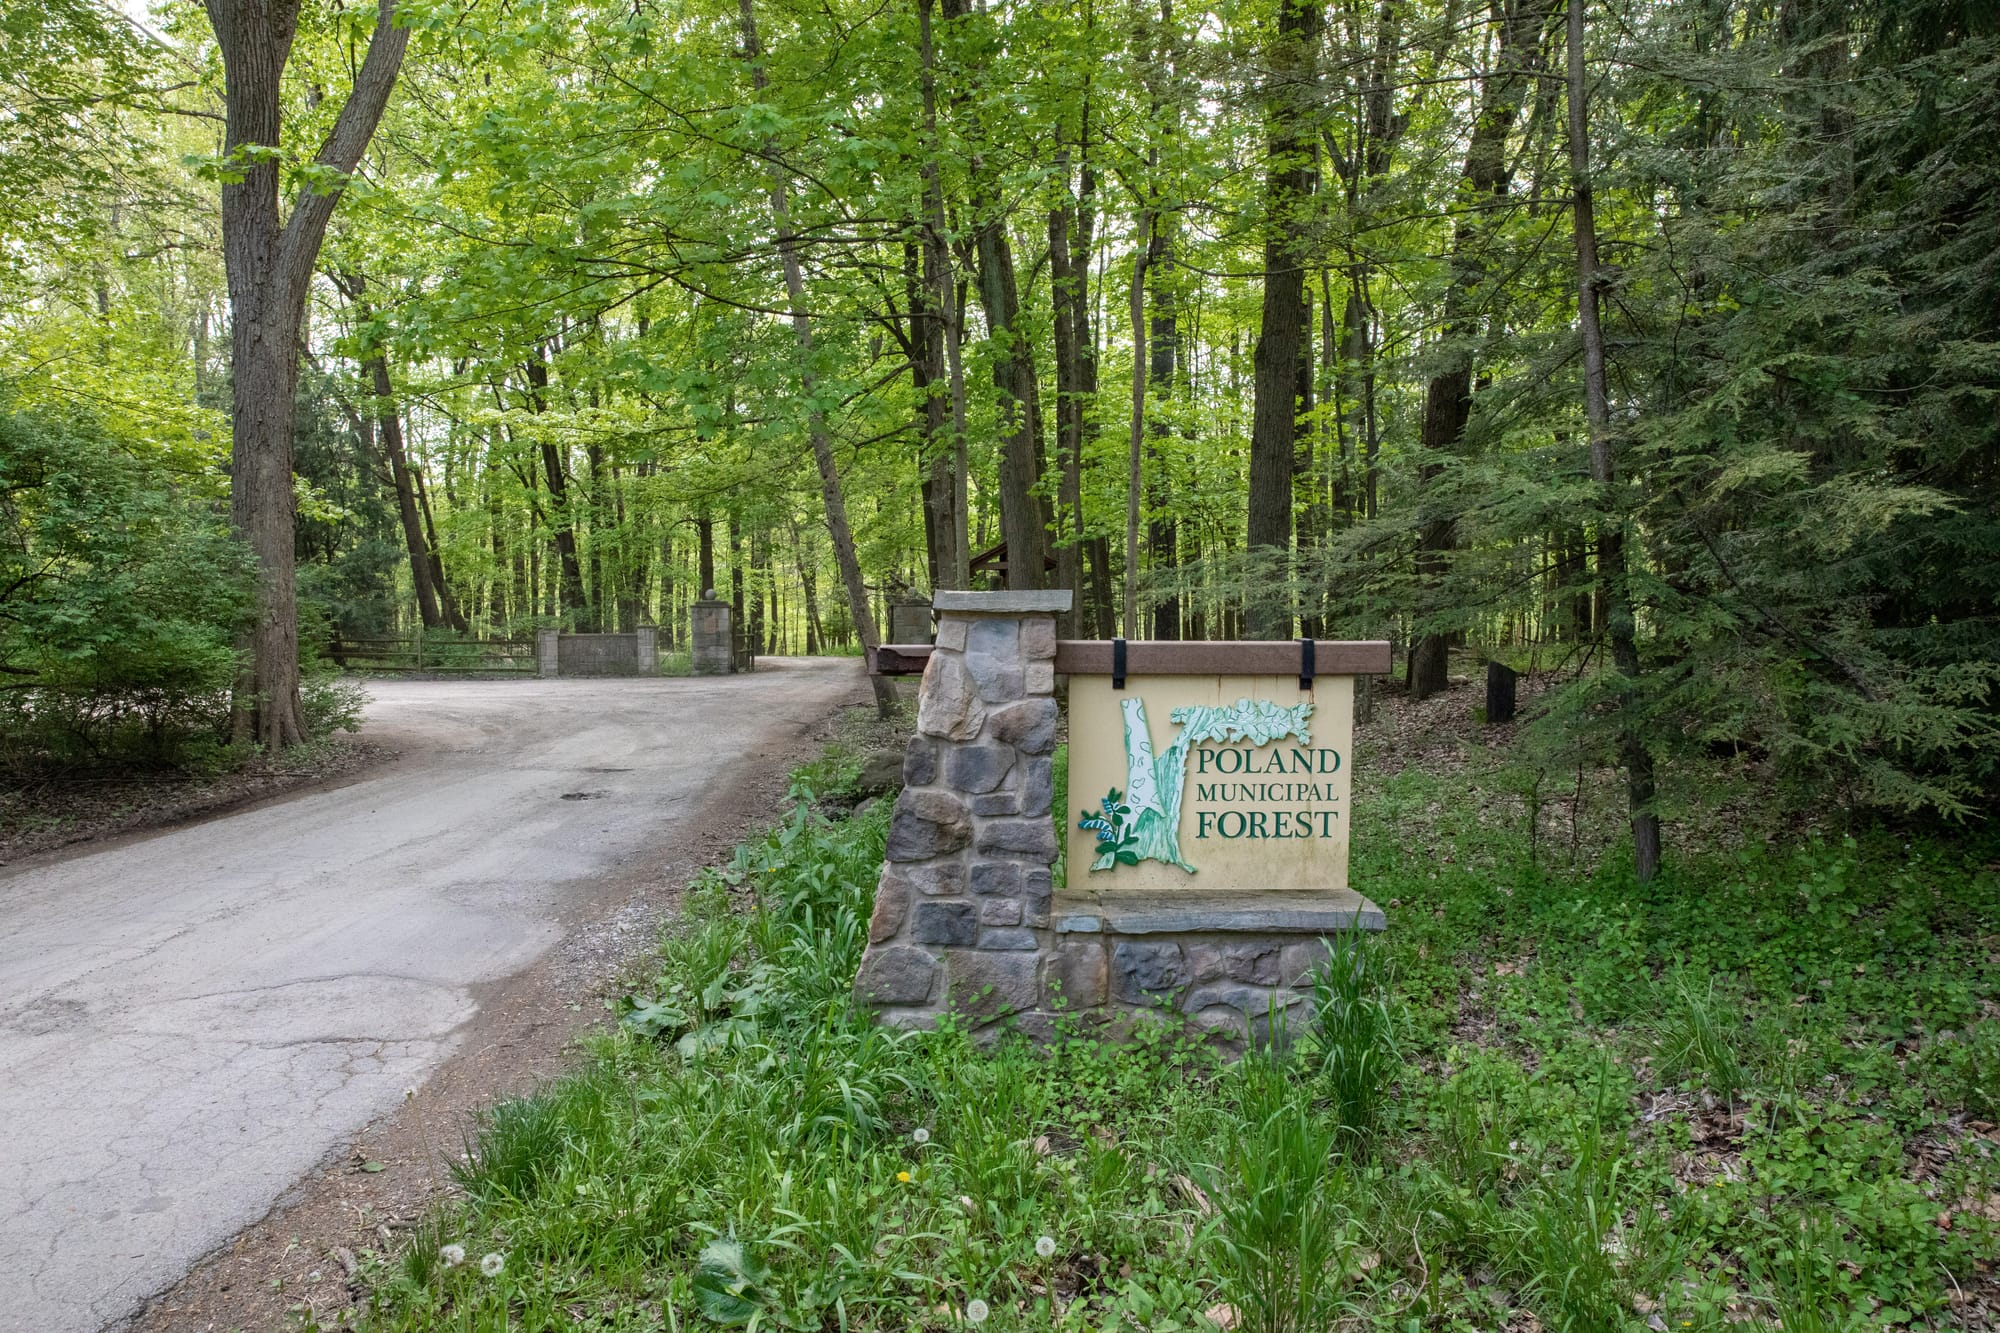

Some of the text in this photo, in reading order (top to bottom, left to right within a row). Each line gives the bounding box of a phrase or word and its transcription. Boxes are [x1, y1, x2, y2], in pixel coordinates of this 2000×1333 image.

[1196, 748, 1341, 774] POLAND
[1195, 783, 1339, 802] MUNICIPAL
[1195, 811, 1339, 839] FOREST
